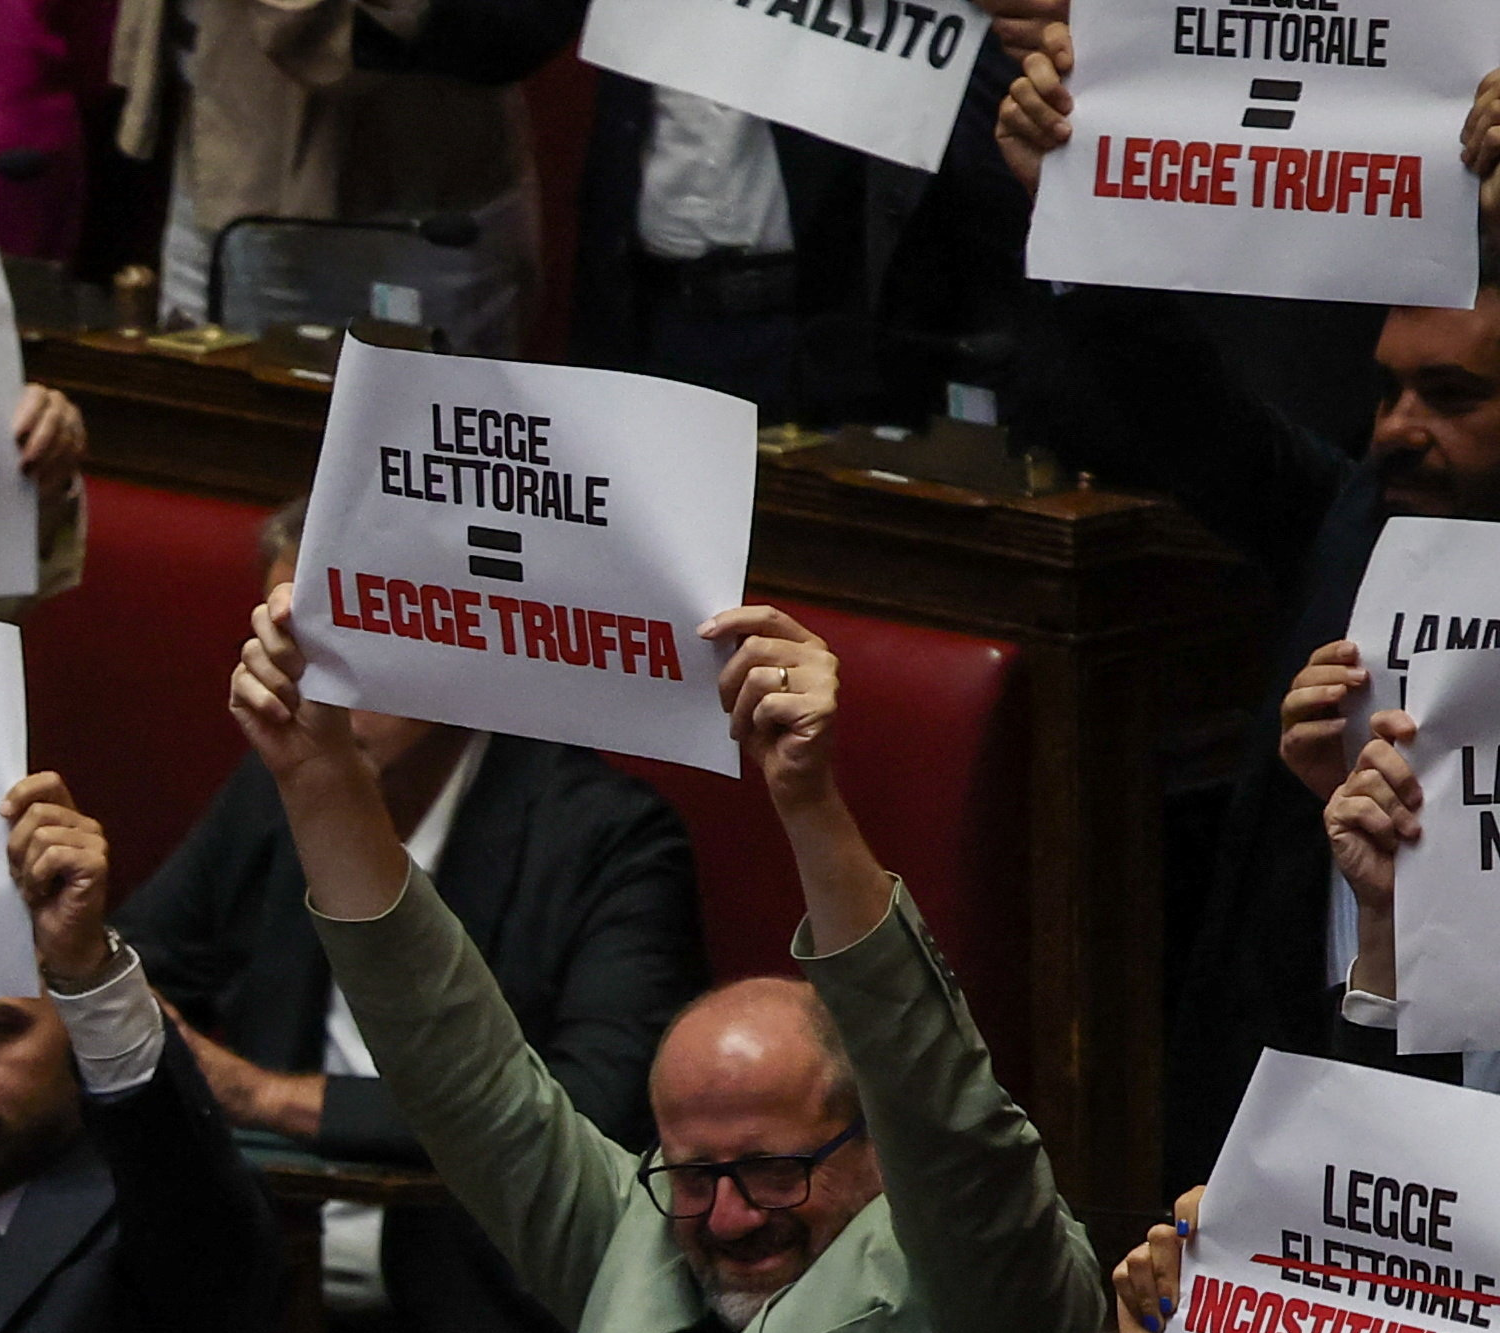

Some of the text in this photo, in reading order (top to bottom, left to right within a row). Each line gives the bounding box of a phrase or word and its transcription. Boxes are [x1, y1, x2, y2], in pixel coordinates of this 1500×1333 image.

[734, 0, 966, 70] LLITO
[1174, 7, 1390, 67] ELETTORALE
[1093, 135, 1422, 218] LEGGE TRUFFA
[433, 403, 551, 466] LEGGE
[381, 448, 609, 527] ELETTORALE
[328, 568, 682, 682] LEGGE TRUFFA
[1323, 1165, 1457, 1252] LEGGE
[1281, 1230, 1495, 1329] ELETTORALE
